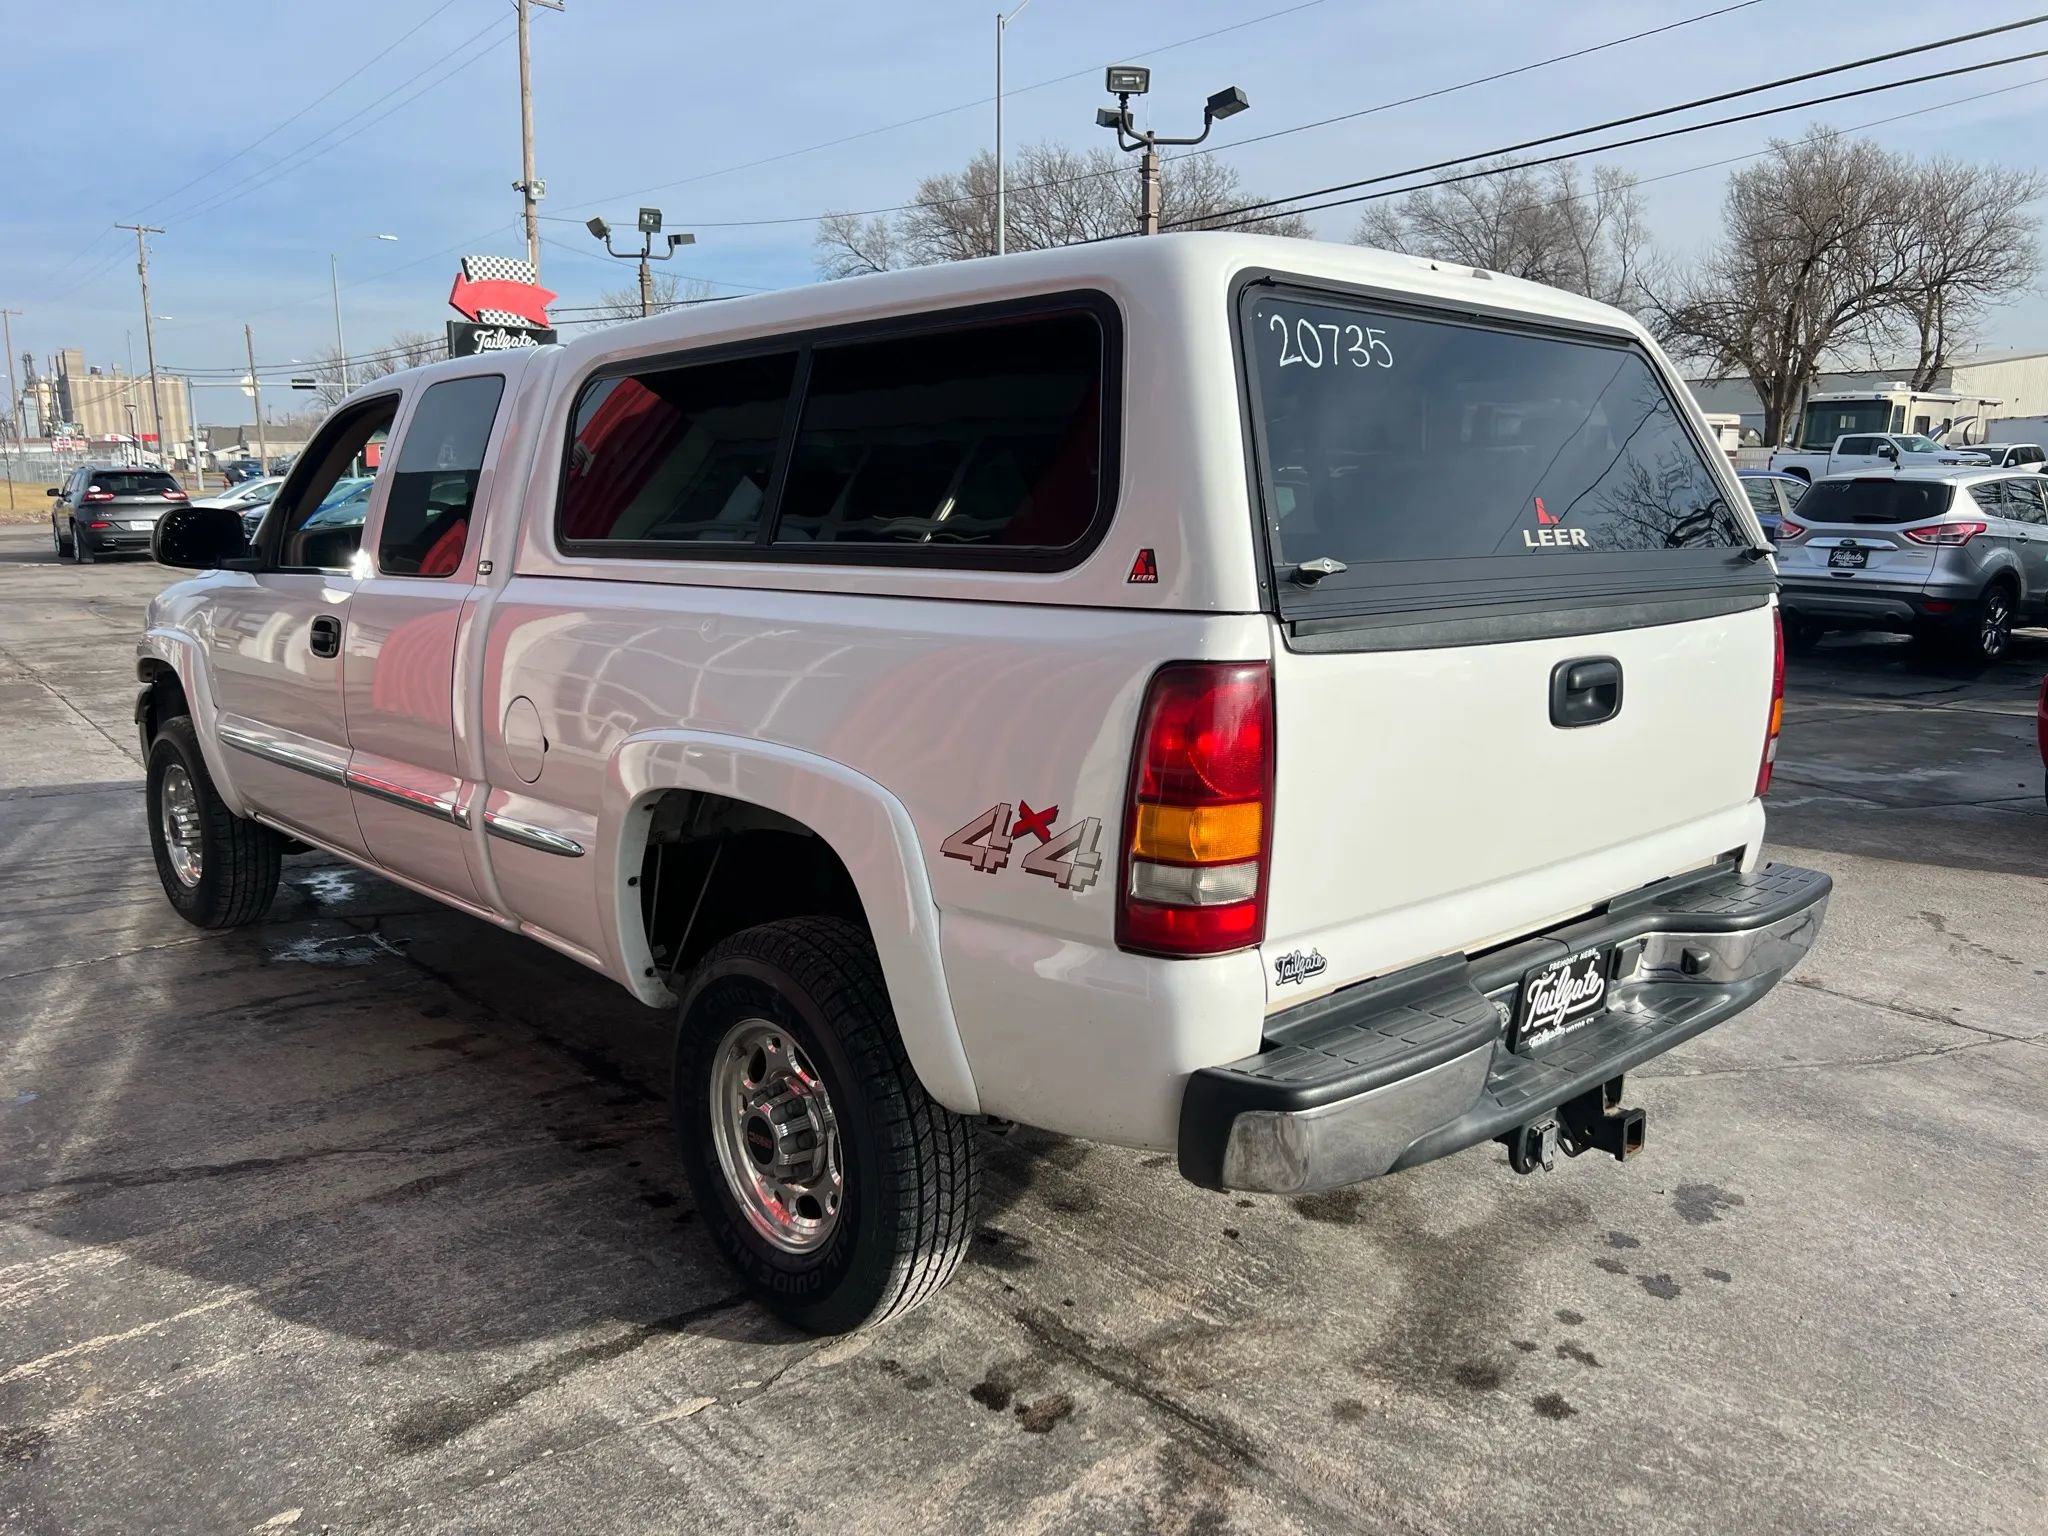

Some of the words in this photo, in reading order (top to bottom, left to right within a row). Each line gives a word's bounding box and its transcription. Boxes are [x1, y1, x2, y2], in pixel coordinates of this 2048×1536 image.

[1269, 313, 1394, 369] 20735
[1523, 527, 1590, 548] LEER
[1130, 574, 1156, 582] LEER
[1275, 947, 1328, 986] Tailgate
[1548, 954, 1579, 972] FREMONT
[1521, 960, 1605, 1032] Tailgate
